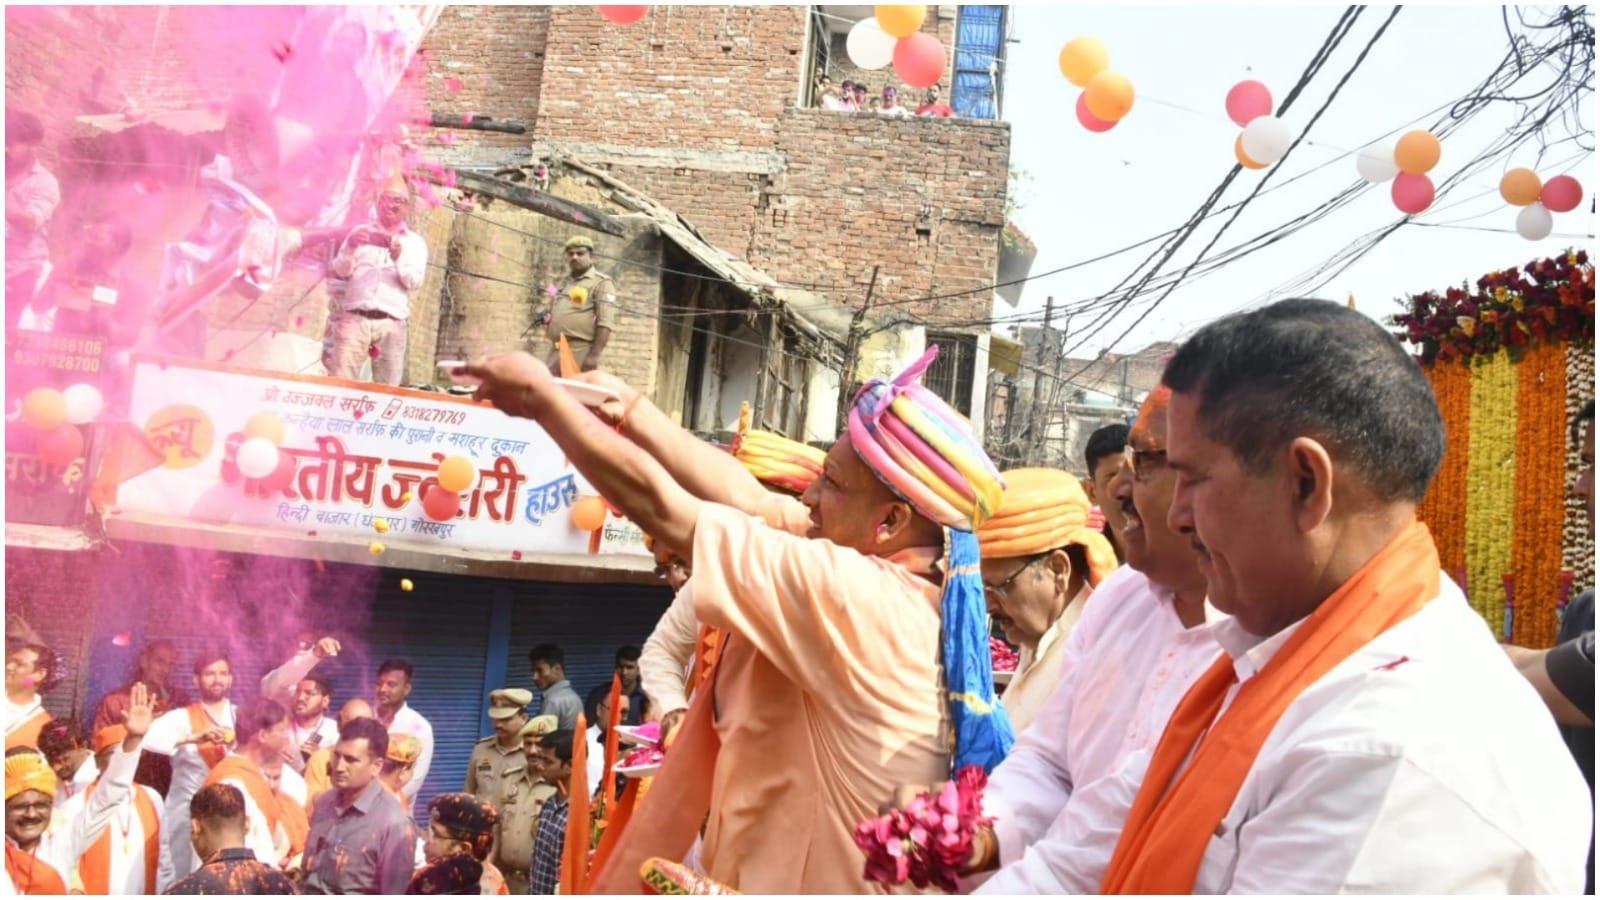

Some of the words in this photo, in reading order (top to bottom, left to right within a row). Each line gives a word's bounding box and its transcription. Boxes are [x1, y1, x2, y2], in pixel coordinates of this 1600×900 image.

[327, 417, 355, 433] लाल
[389, 421, 407, 439] की
[448, 432, 488, 457] मशहूर
[490, 438, 531, 457] दुकान
[525, 473, 578, 525] हाउस
[276, 503, 311, 523] हिन्दी
[411, 517, 456, 539] गोरखपुर
